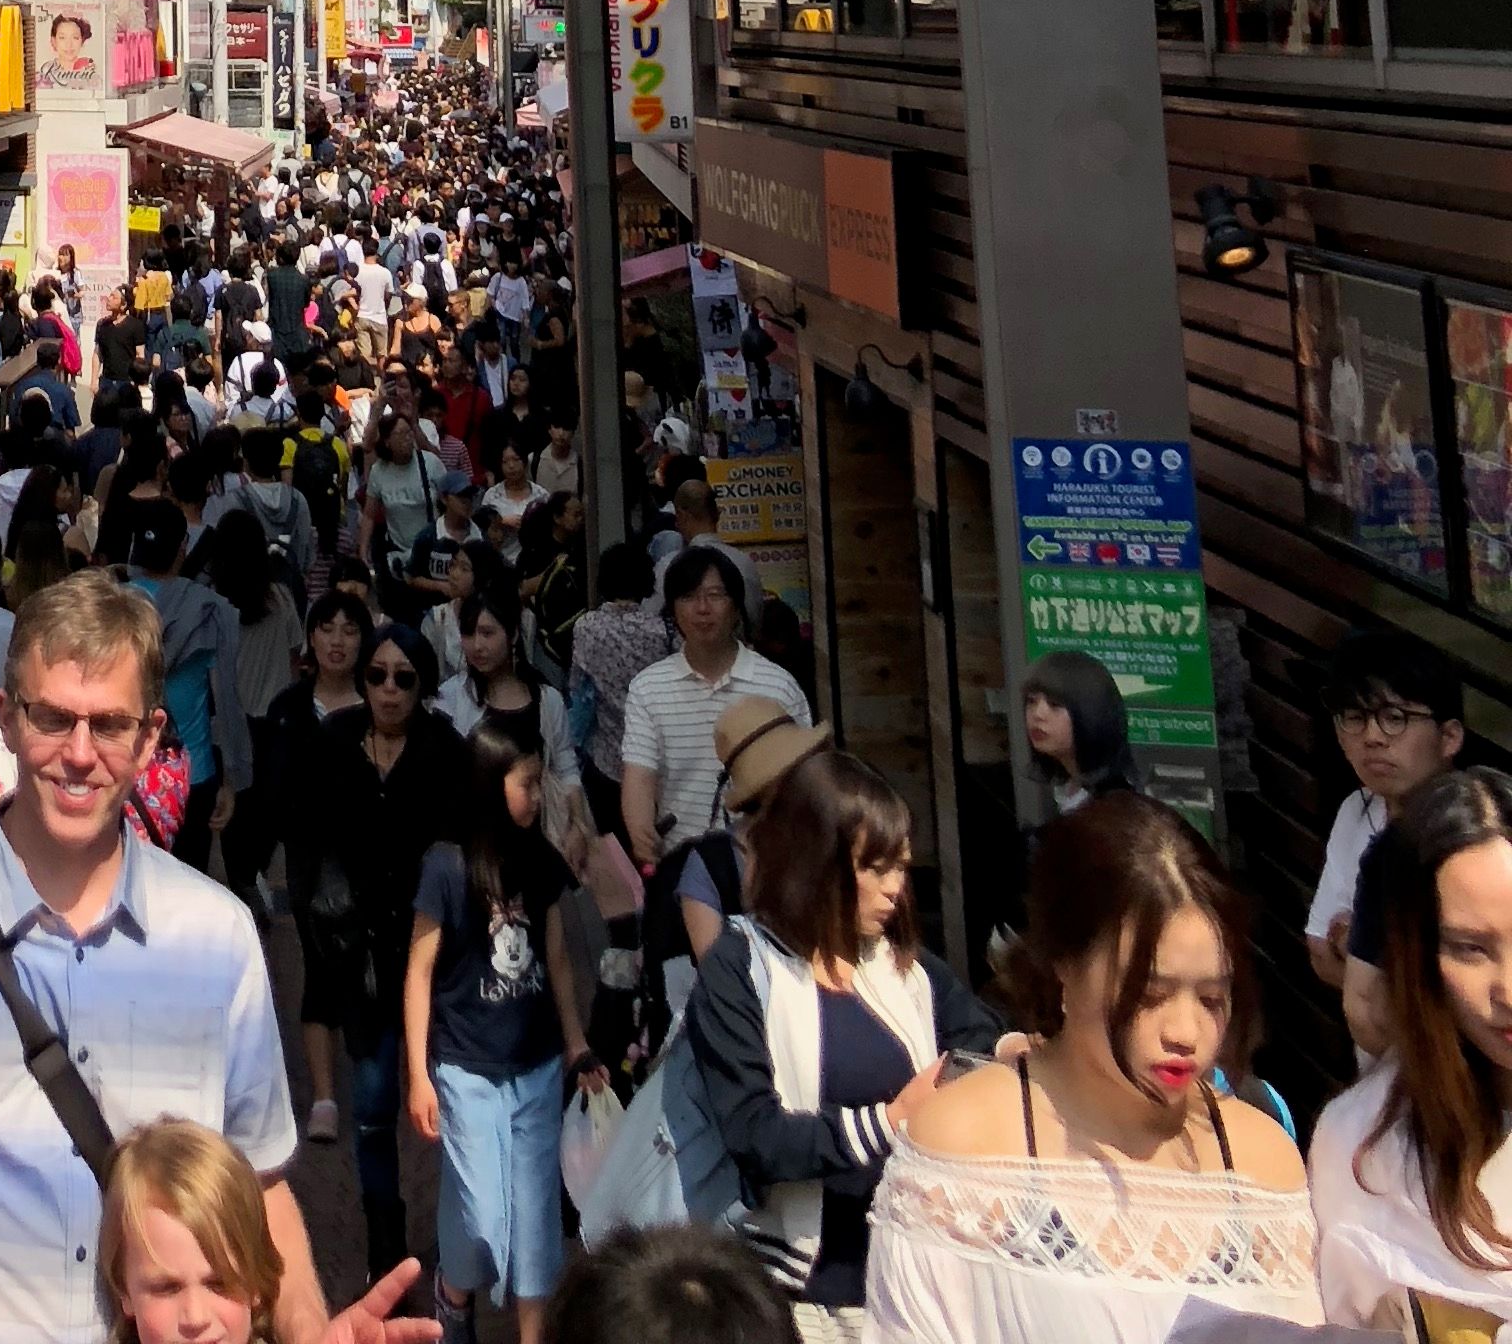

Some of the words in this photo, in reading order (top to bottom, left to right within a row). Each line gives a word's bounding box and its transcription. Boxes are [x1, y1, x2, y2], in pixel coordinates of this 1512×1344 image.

[742, 465, 794, 479] MONEY
[1053, 482, 1108, 493] HARAJUKU
[1111, 484, 1155, 494] TOURIST
[1046, 494, 1121, 506] INFORMATION
[1123, 495, 1164, 506] CENTER
[1029, 596, 1201, 636] 竹下通り公式マップ
